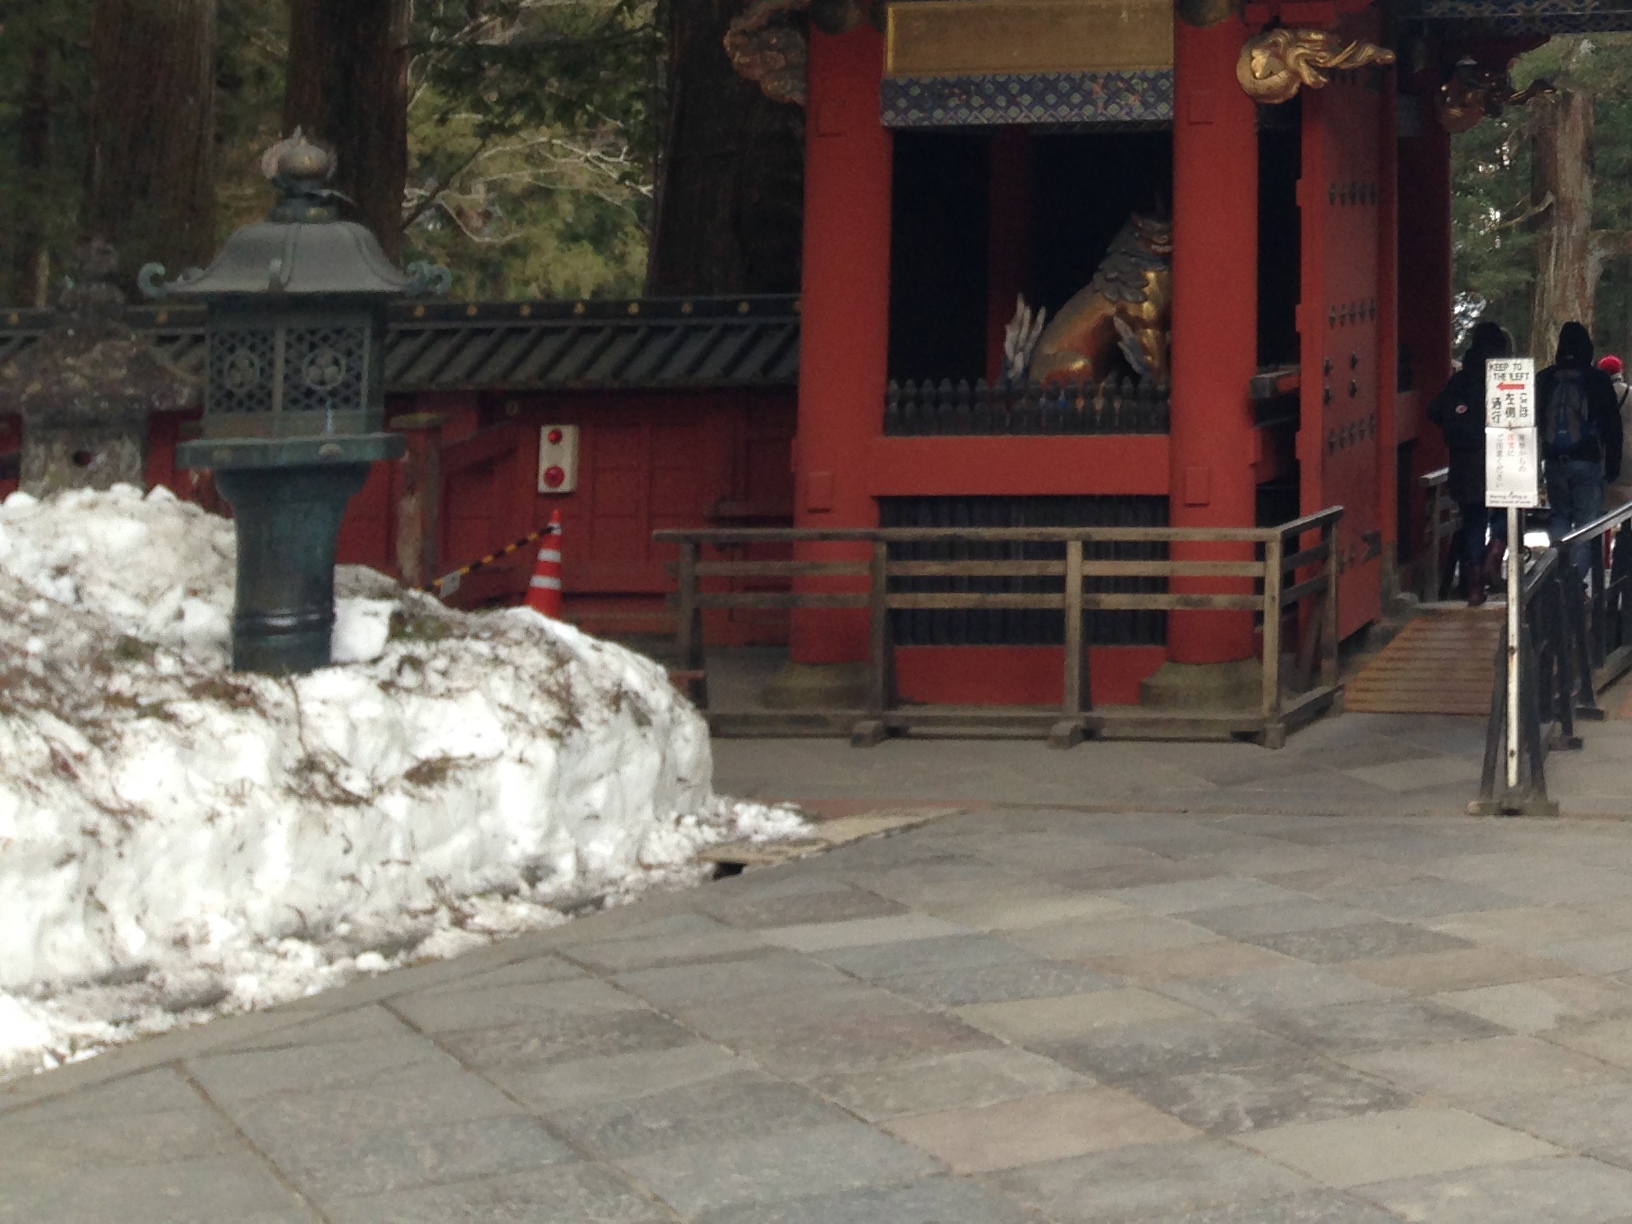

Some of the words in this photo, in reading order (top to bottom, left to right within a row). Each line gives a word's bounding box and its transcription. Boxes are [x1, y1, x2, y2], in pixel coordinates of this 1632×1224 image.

[1489, 363, 1509, 371] KEEP
[1513, 363, 1522, 371] TO
[1493, 372, 1507, 380] THE
[1509, 372, 1529, 381] LEFT
[1491, 397, 1502, 423] 通行
[1505, 393, 1516, 418] 左側
